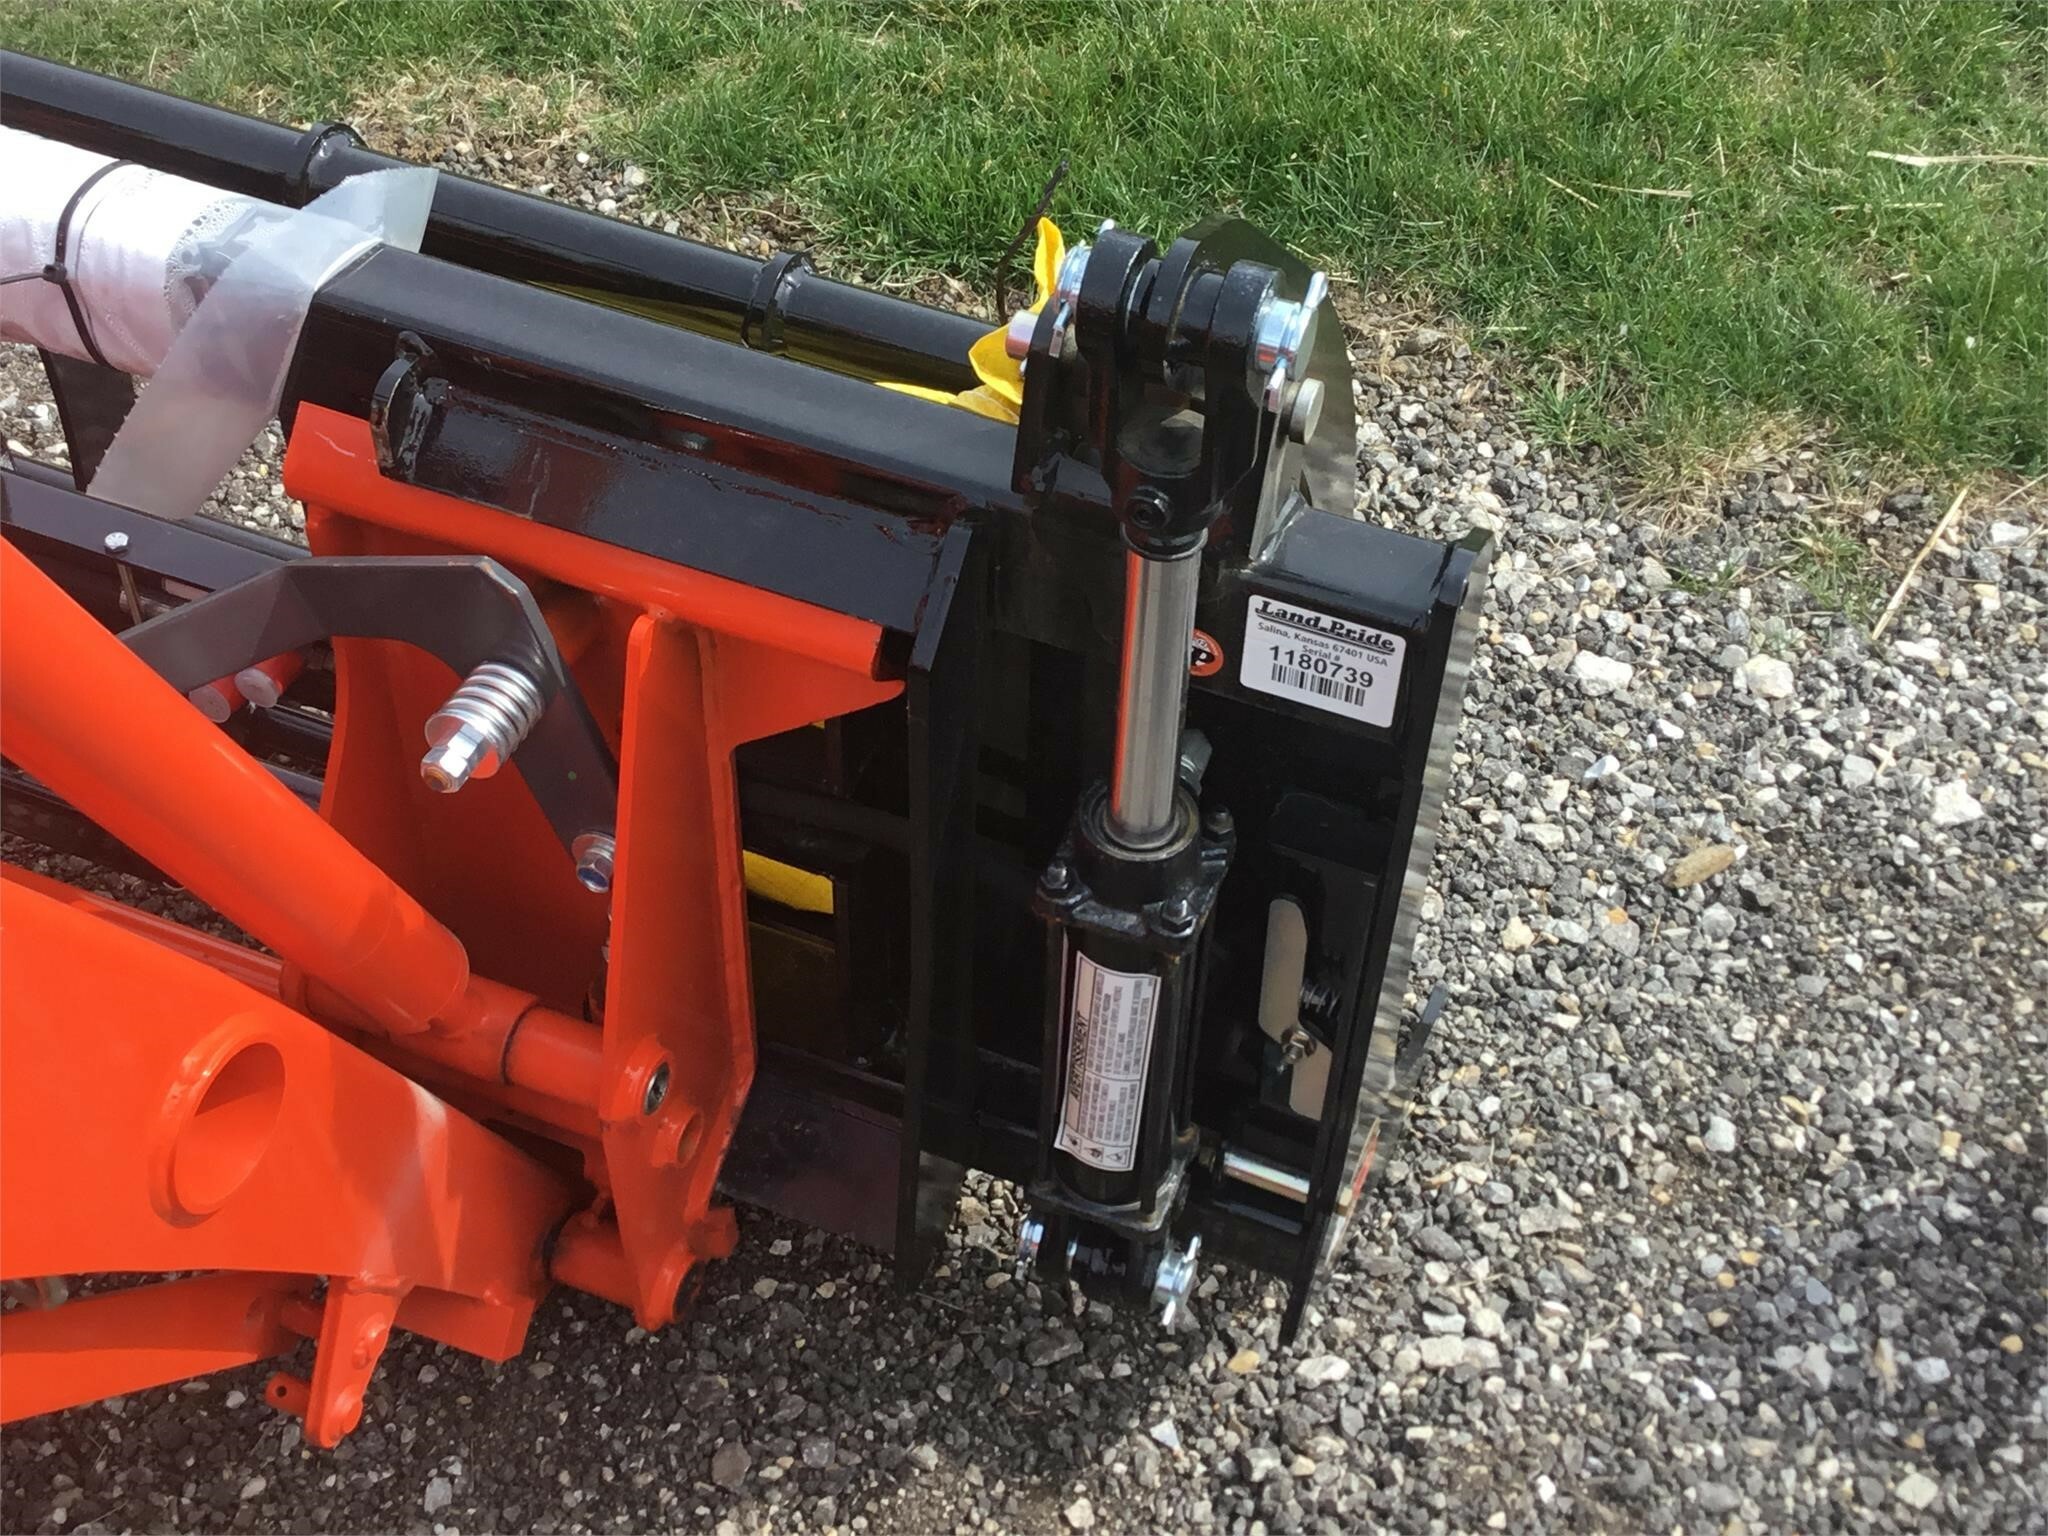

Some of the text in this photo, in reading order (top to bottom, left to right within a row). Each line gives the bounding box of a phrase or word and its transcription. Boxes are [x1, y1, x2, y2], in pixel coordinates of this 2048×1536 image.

[1256, 600, 1395, 653] Land Pride
[1257, 622, 1388, 667] Salina, Kansas 67401 USA
[1269, 645, 1374, 688] 1180739
[1302, 644, 1331, 660] Serial
